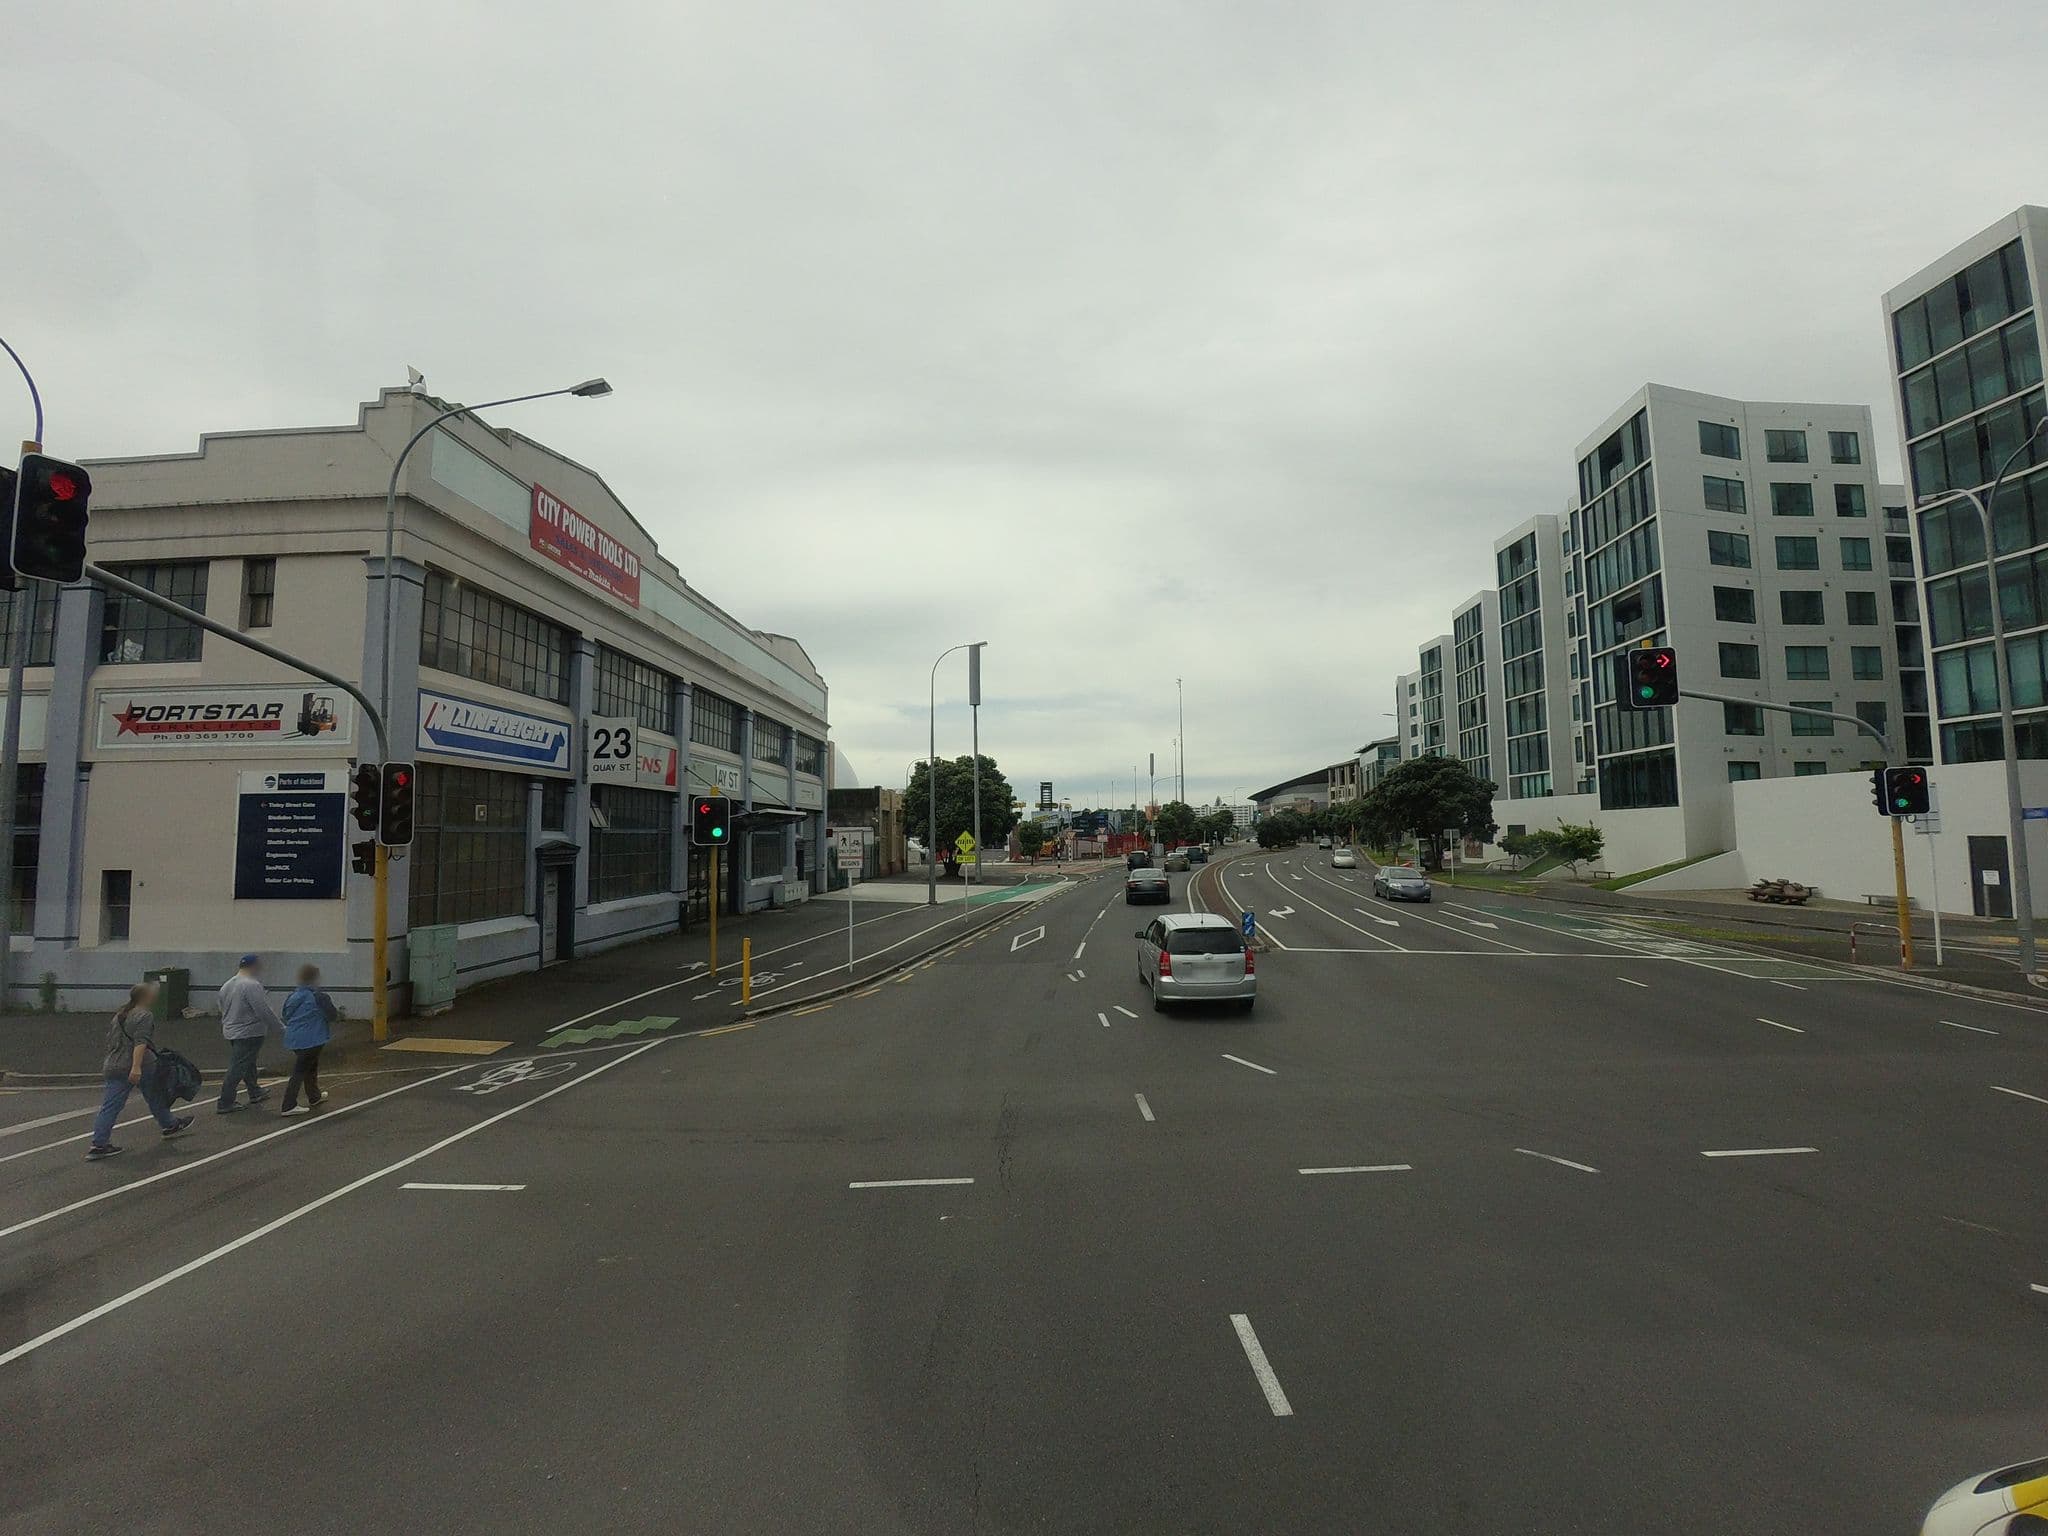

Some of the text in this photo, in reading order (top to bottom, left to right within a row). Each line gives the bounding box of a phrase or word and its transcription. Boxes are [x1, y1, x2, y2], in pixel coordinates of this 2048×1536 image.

[538, 491, 560, 527] CITY
[562, 508, 596, 552] POWER
[598, 532, 623, 569] TOOLS
[624, 551, 639, 578] LTD
[128, 702, 284, 722] PORTSTAR
[425, 702, 562, 749] MAINFREIGHT
[593, 728, 631, 759] 23
[593, 764, 616, 772] QUAY
[729, 771, 738, 789] ST
